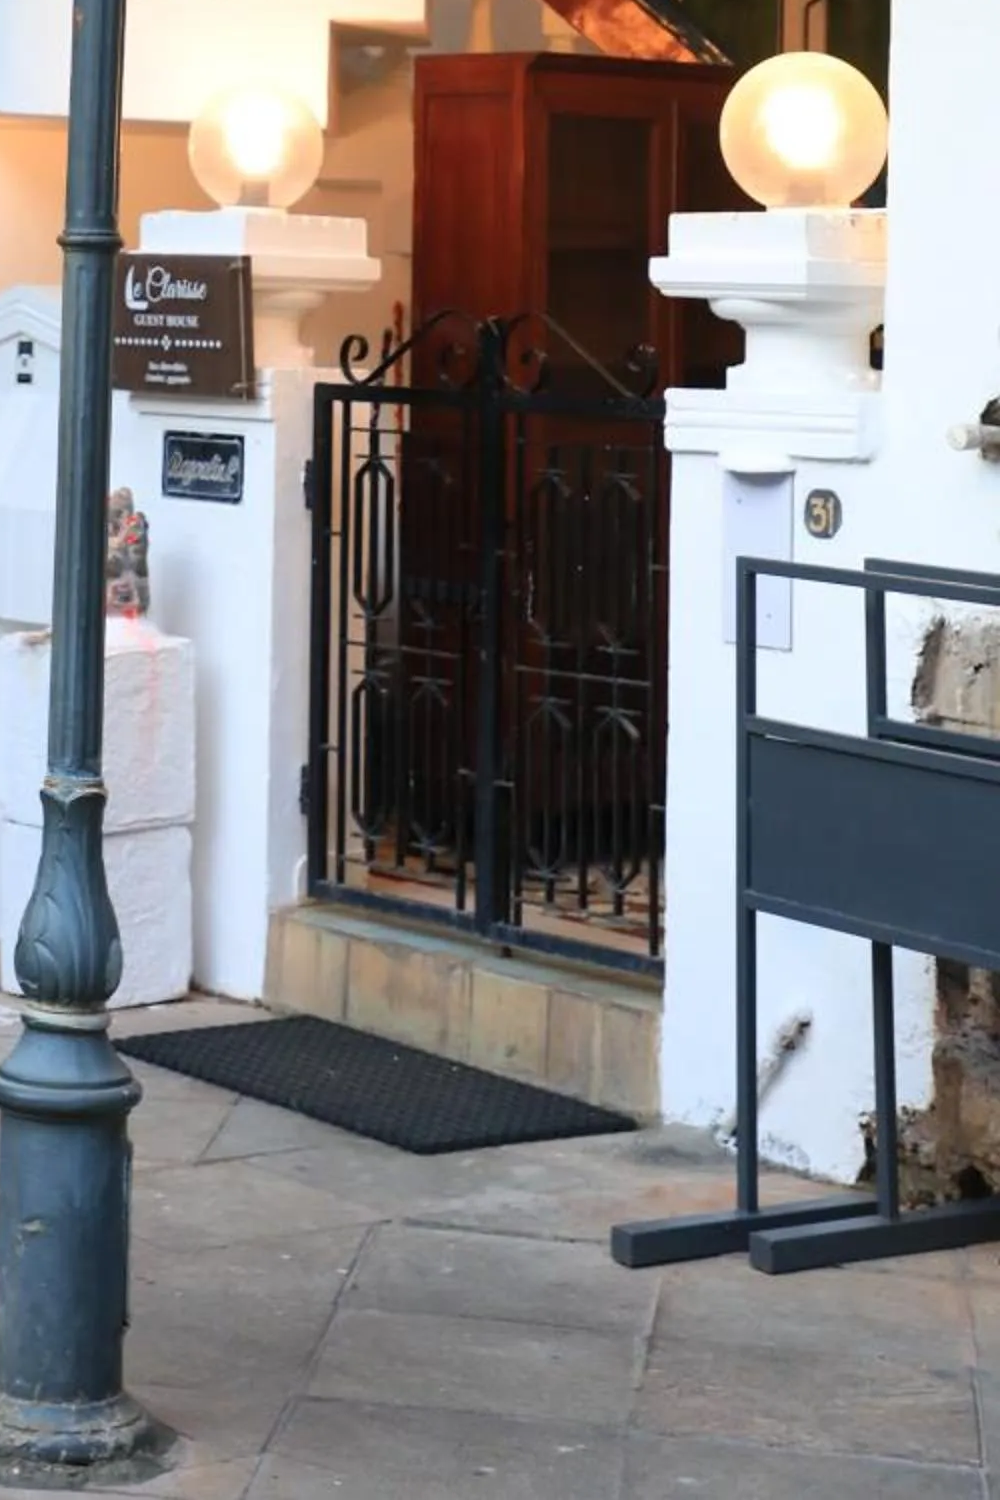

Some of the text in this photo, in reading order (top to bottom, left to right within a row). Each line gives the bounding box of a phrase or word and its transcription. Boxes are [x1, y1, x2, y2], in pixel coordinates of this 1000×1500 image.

[125, 264, 207, 311] Le Clarisse
[133, 313, 200, 330] GUEST HOUSE
[809, 497, 835, 535] 31
